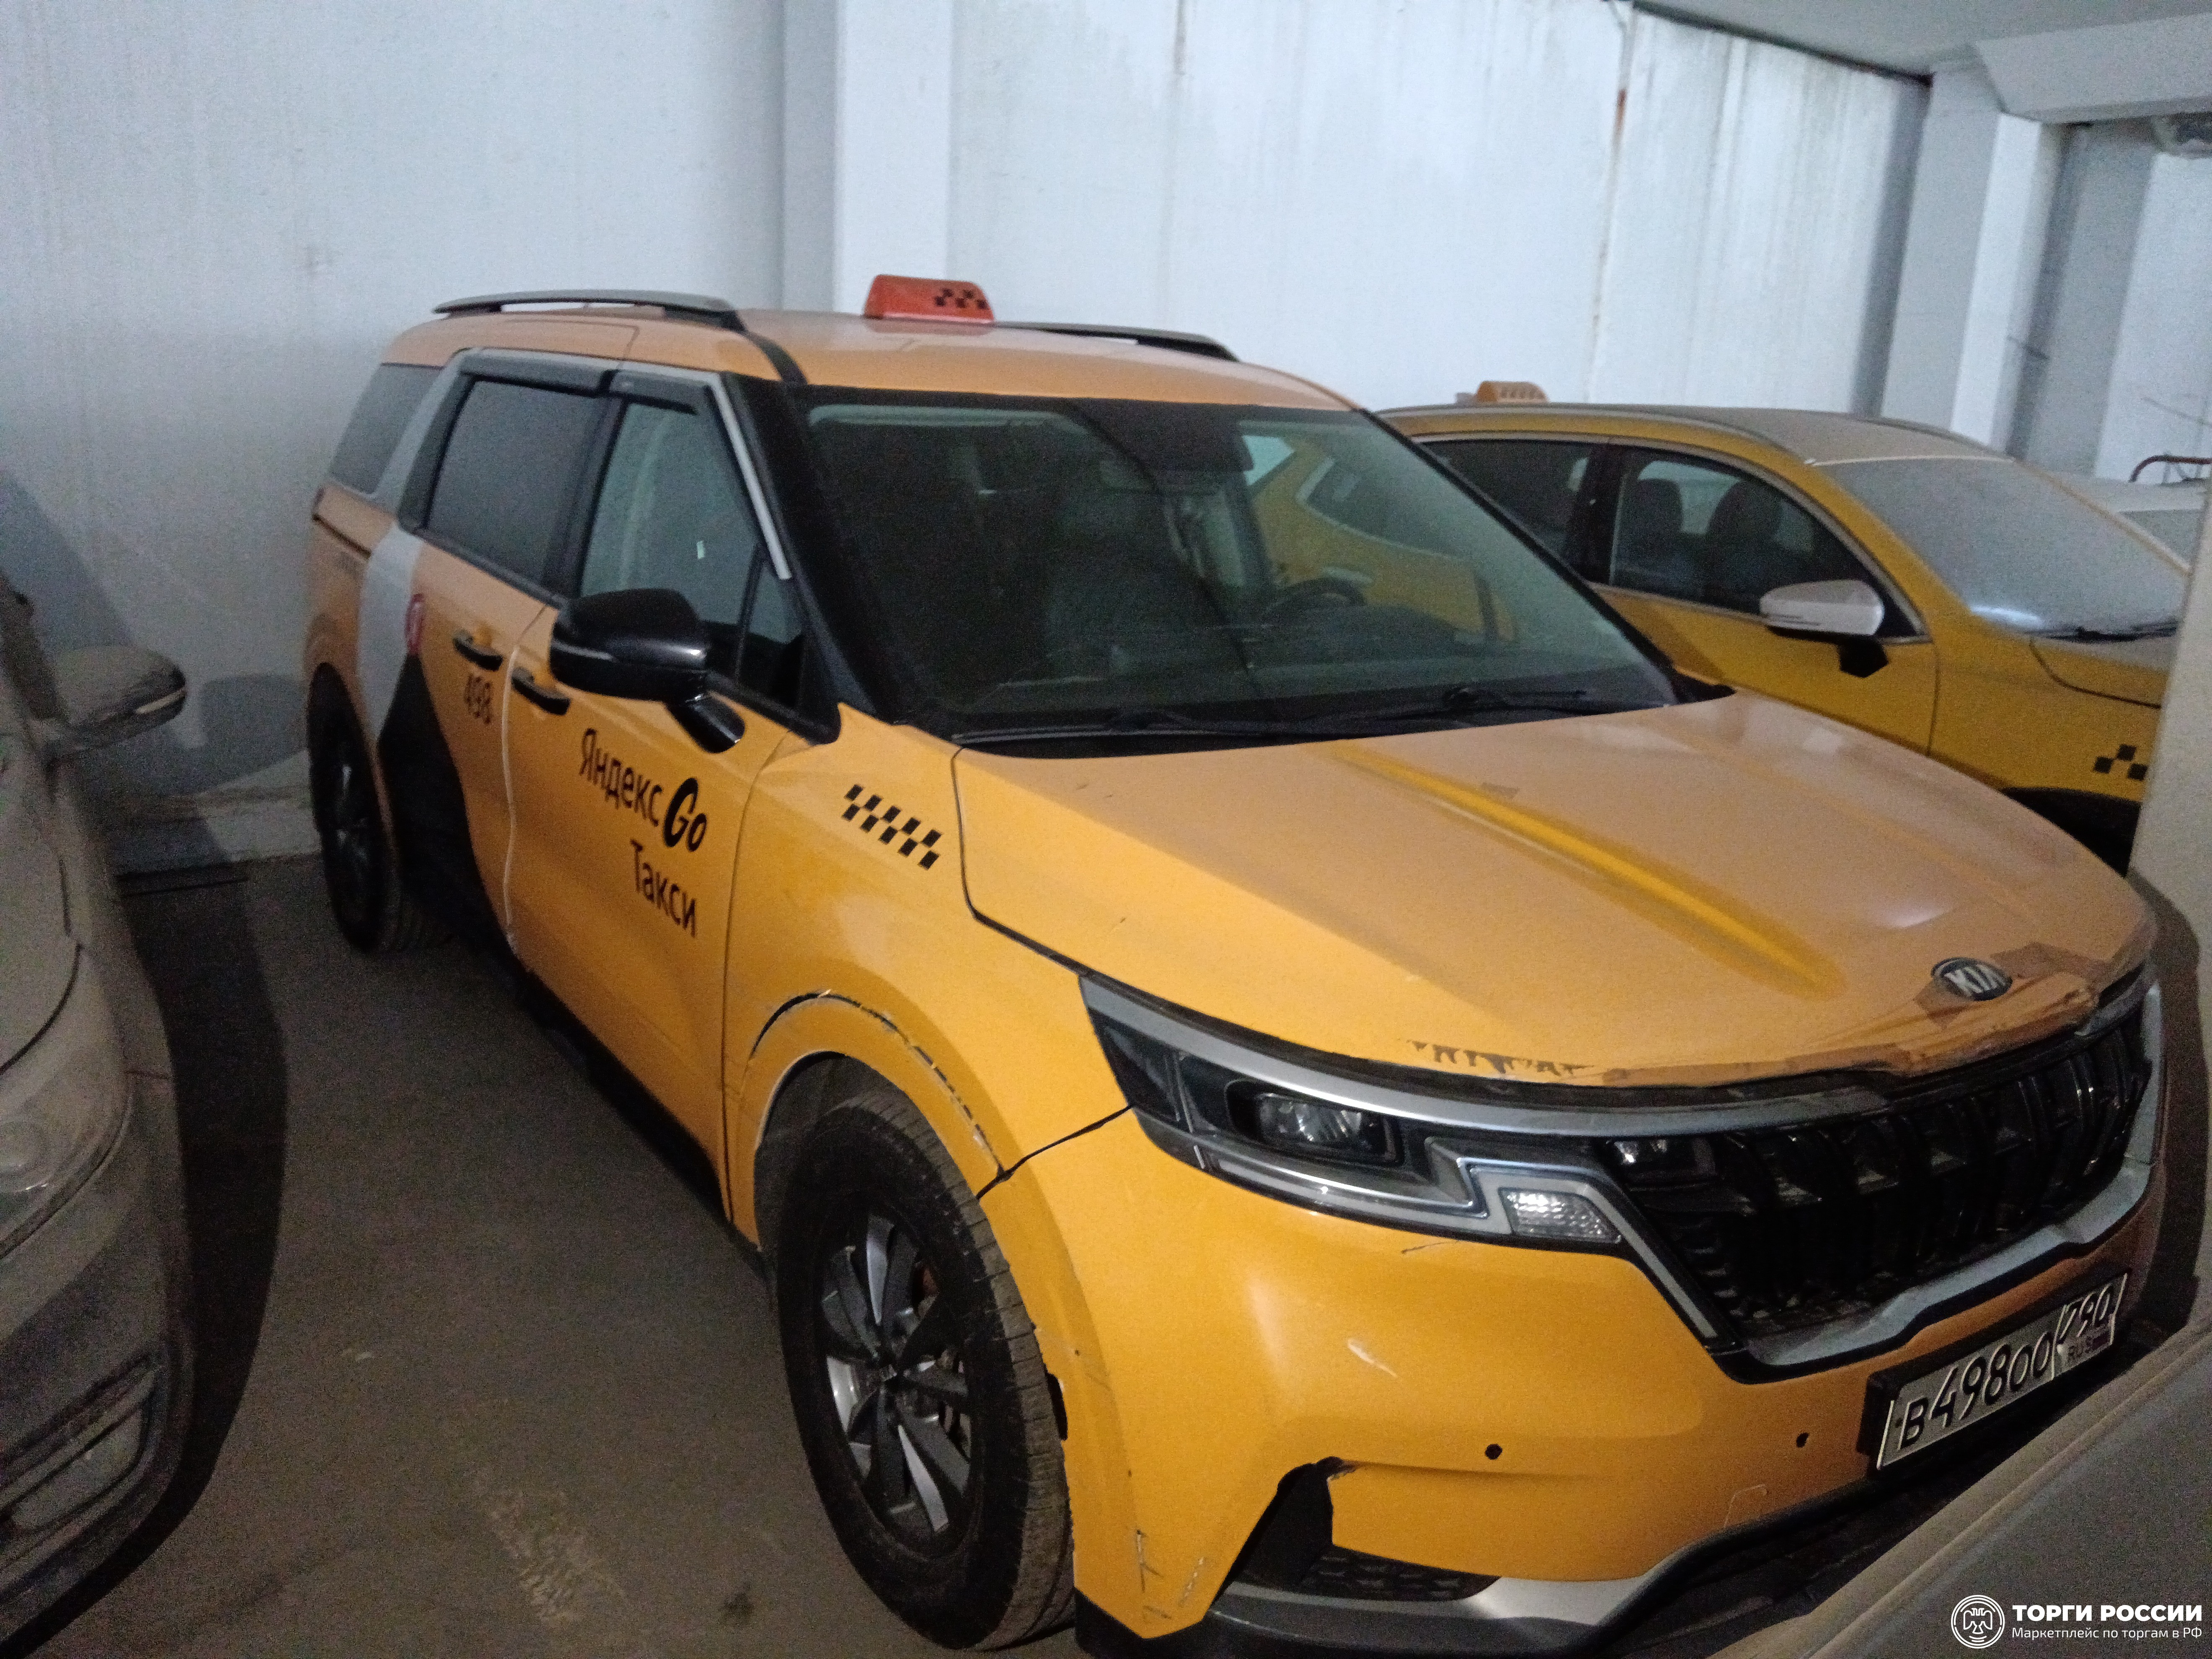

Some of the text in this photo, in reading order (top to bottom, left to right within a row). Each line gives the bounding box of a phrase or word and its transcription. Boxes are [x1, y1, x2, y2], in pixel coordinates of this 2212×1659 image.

[579, 728, 707, 851] Яндекс Go
[629, 839, 696, 938] Такси
